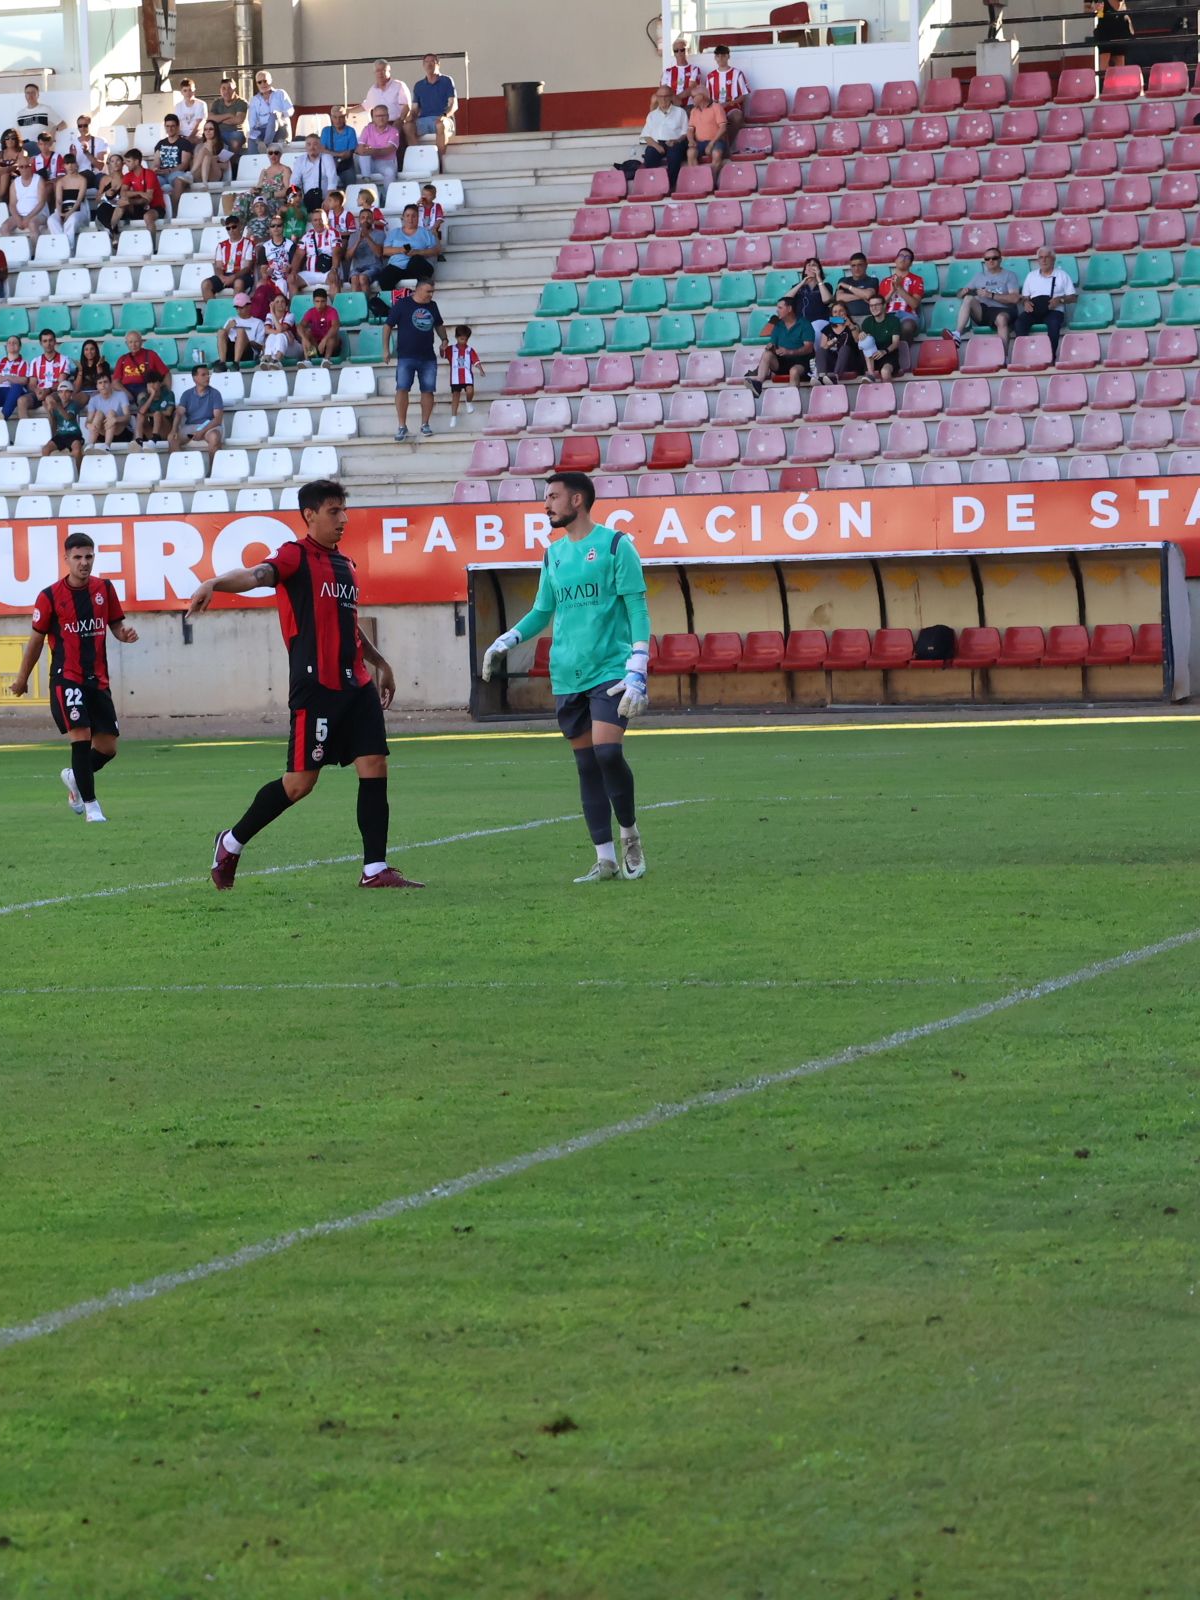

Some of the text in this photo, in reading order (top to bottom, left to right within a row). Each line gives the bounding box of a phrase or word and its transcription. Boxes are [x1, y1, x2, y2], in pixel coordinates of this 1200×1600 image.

[382, 492, 872, 554] FABRCACIÓN
[952, 493, 1036, 534] DE
[556, 582, 599, 603] UXADI
[64, 617, 105, 633] AUXADI
[65, 687, 83, 707] 22
[315, 717, 328, 742] 5
